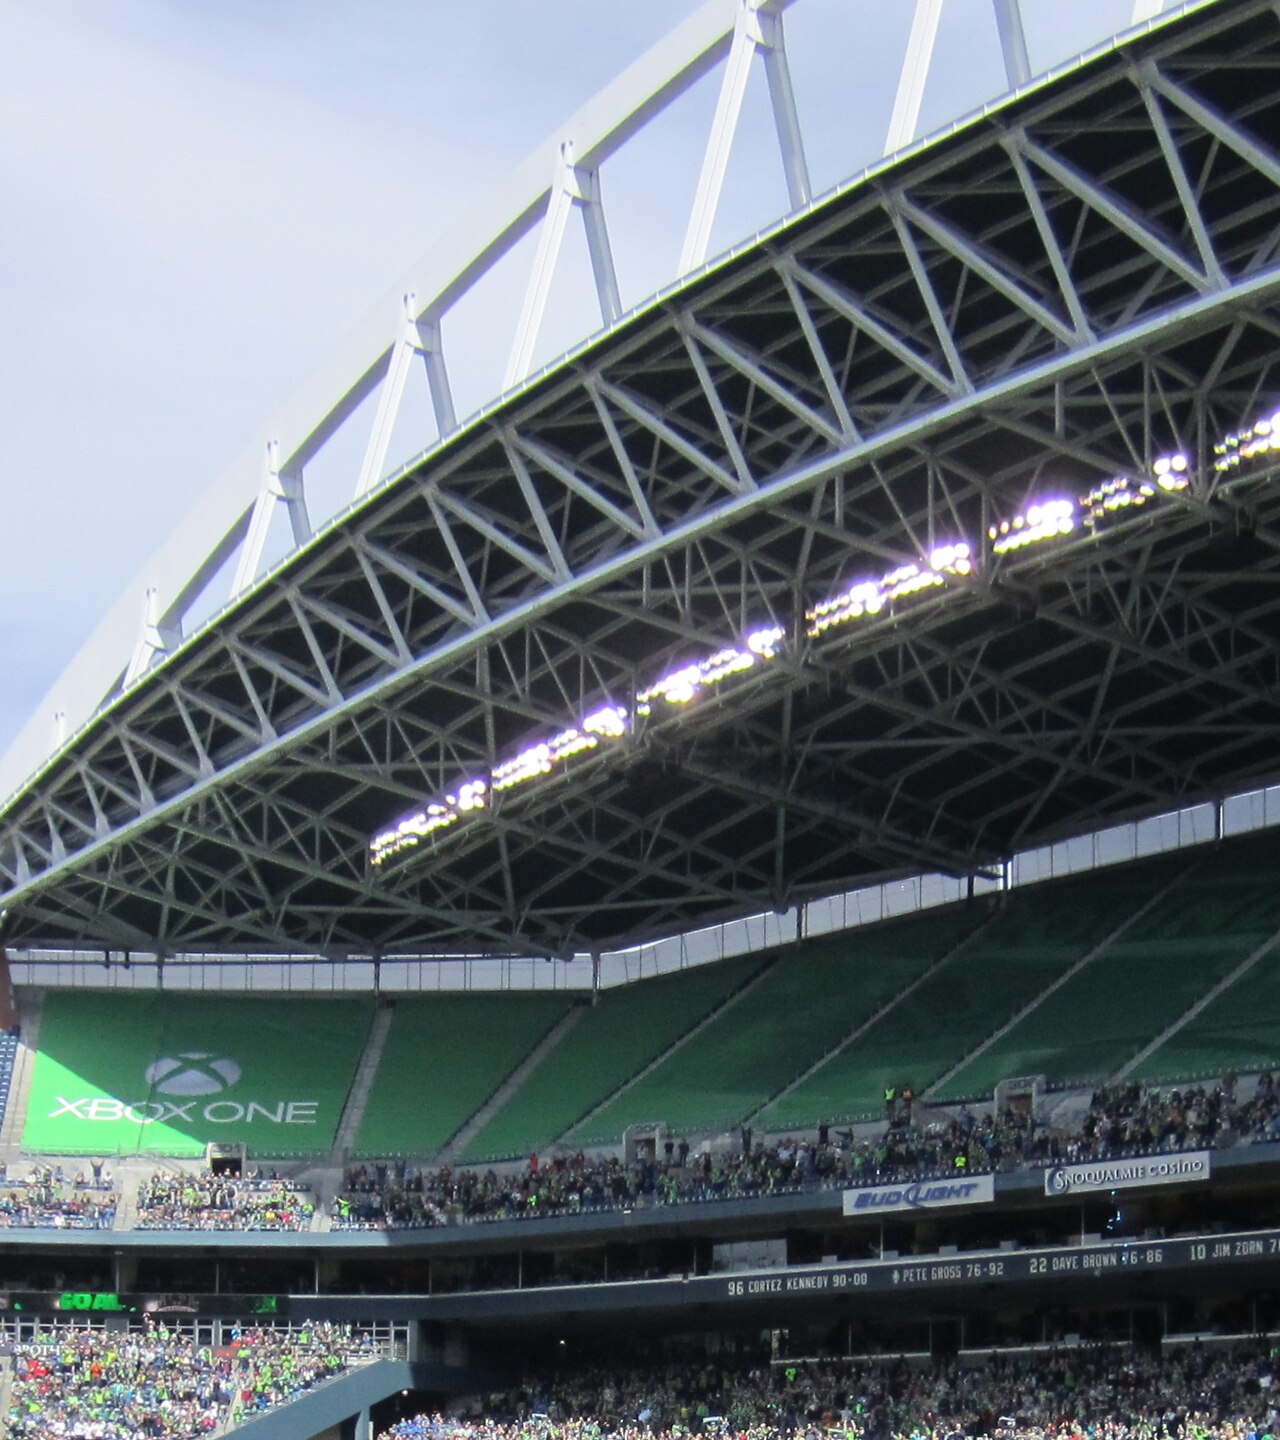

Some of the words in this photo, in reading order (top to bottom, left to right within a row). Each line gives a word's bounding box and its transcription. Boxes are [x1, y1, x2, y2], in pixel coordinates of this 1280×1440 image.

[47, 1095, 197, 1124] XBOX
[203, 1101, 320, 1124] ONE
[1054, 1164, 1146, 1190] SNOQUALMIE
[1148, 1158, 1204, 1177] casino
[853, 1190, 904, 1209] BUD
[917, 1183, 979, 1200] LIGHT
[1190, 1244, 1207, 1261] 10
[1212, 1243, 1231, 1258] JIM
[1234, 1240, 1264, 1256] ZORN
[902, 1267, 928, 1282] PETE
[931, 1265, 962, 1280] GROSS
[966, 1262, 1004, 1277] 76-92
[1029, 1258, 1048, 1273] 22
[1051, 1254, 1079, 1271] DAVE
[1082, 1252, 1117, 1268] BROWN
[727, 1281, 744, 1296] 96
[748, 1278, 783, 1293] CORTEZ
[786, 1275, 829, 1290] KENNEDY
[59, 1292, 122, 1311] GOAL
